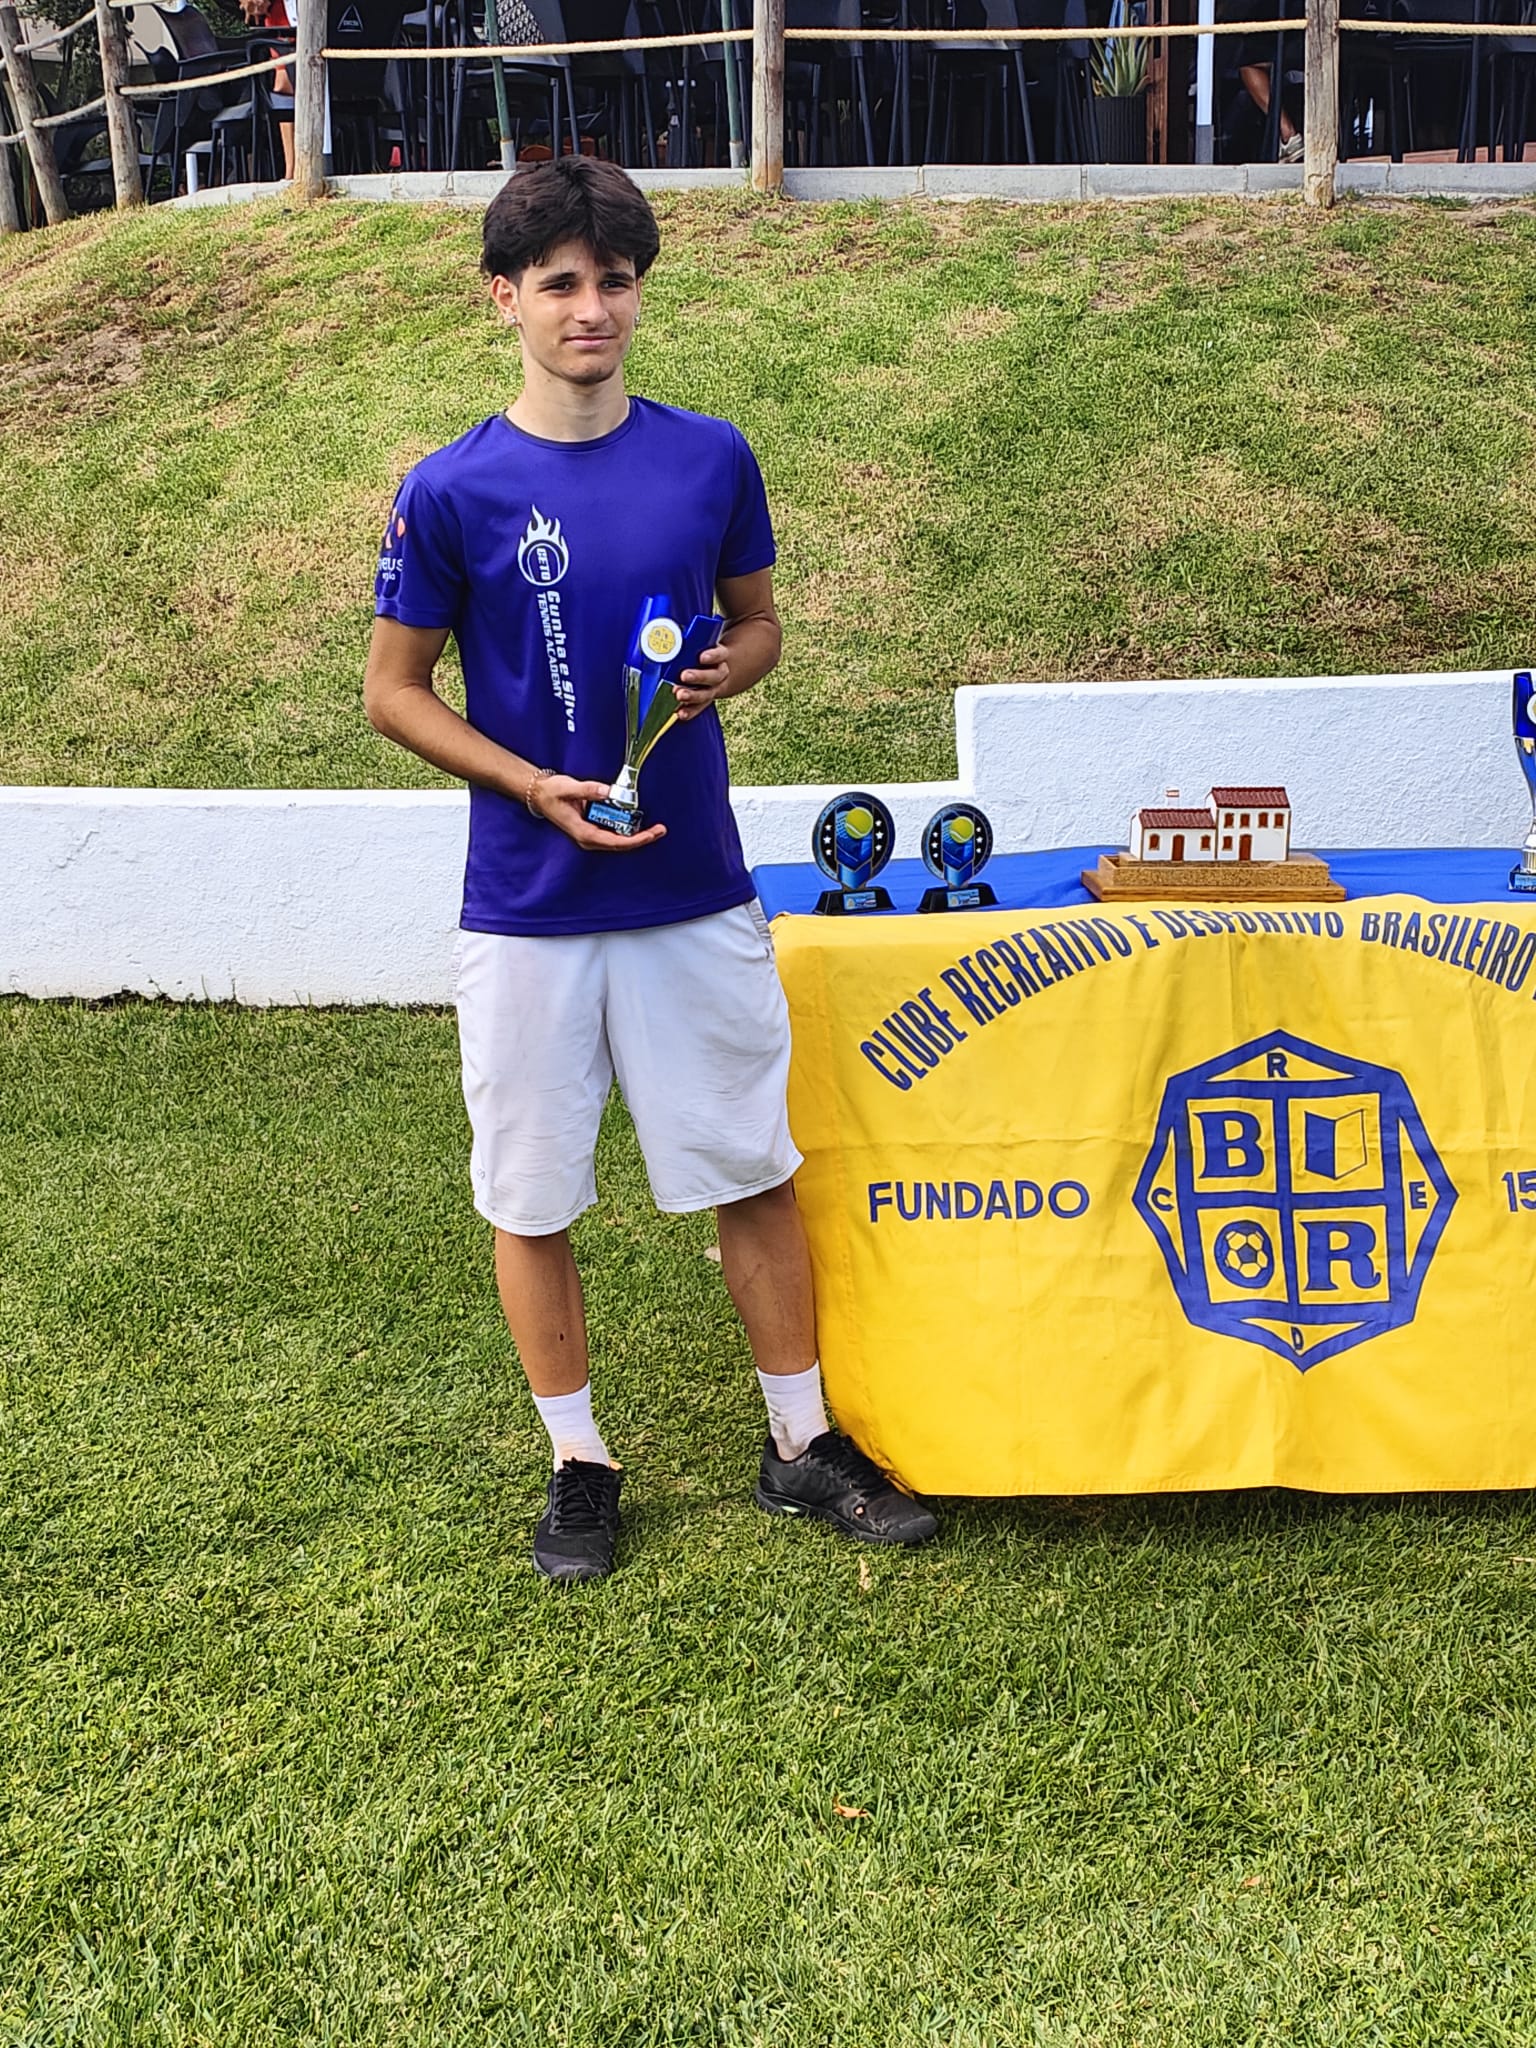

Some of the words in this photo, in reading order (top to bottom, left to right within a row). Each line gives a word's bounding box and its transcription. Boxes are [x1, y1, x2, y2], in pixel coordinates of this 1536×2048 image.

[537, 592, 552, 637] TENNIS
[545, 638, 563, 700] ACADEMY
[559, 663, 569, 676] e
[860, 987, 969, 1091] CLUBE
[939, 917, 1133, 1027] RECREATIVO
[1123, 915, 1160, 950] E
[1150, 910, 1344, 939] DESPORTIVO
[1360, 911, 1536, 992] BRASILEIRO
[1266, 1052, 1290, 1078] R
[1192, 1110, 1265, 1179] B
[868, 1180, 1090, 1223] FUNDADO
[1151, 1187, 1174, 1212] C
[1409, 1181, 1427, 1209] E
[1298, 1221, 1382, 1292] R
[1290, 1326, 1304, 1350] D
